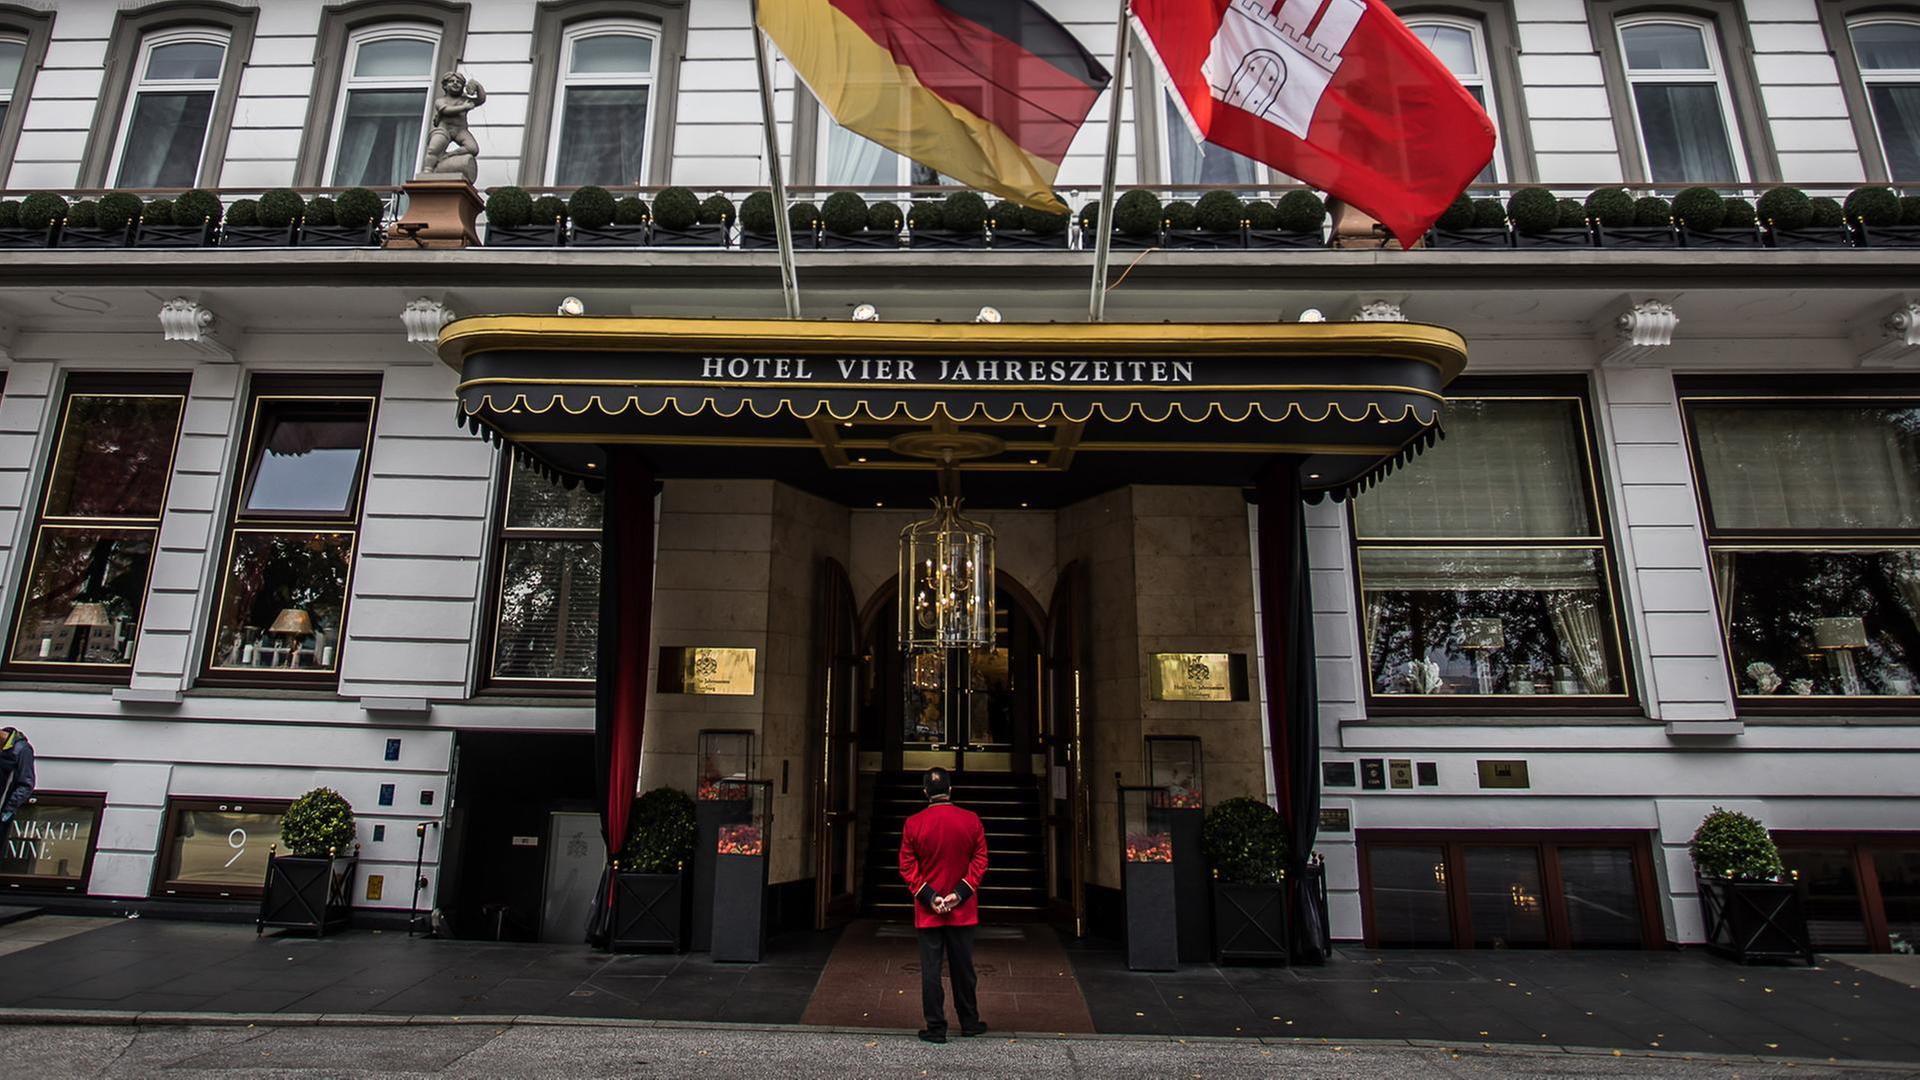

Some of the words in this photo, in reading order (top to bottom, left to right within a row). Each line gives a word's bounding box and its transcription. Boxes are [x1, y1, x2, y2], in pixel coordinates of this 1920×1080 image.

[701, 357, 812, 379] HOTEL
[836, 359, 917, 381] VIER
[938, 360, 1194, 382] JAHRESZEITEN
[9, 820, 79, 840] NIKKEI
[5, 840, 54, 860] NINE
[224, 828, 247, 868] 9
